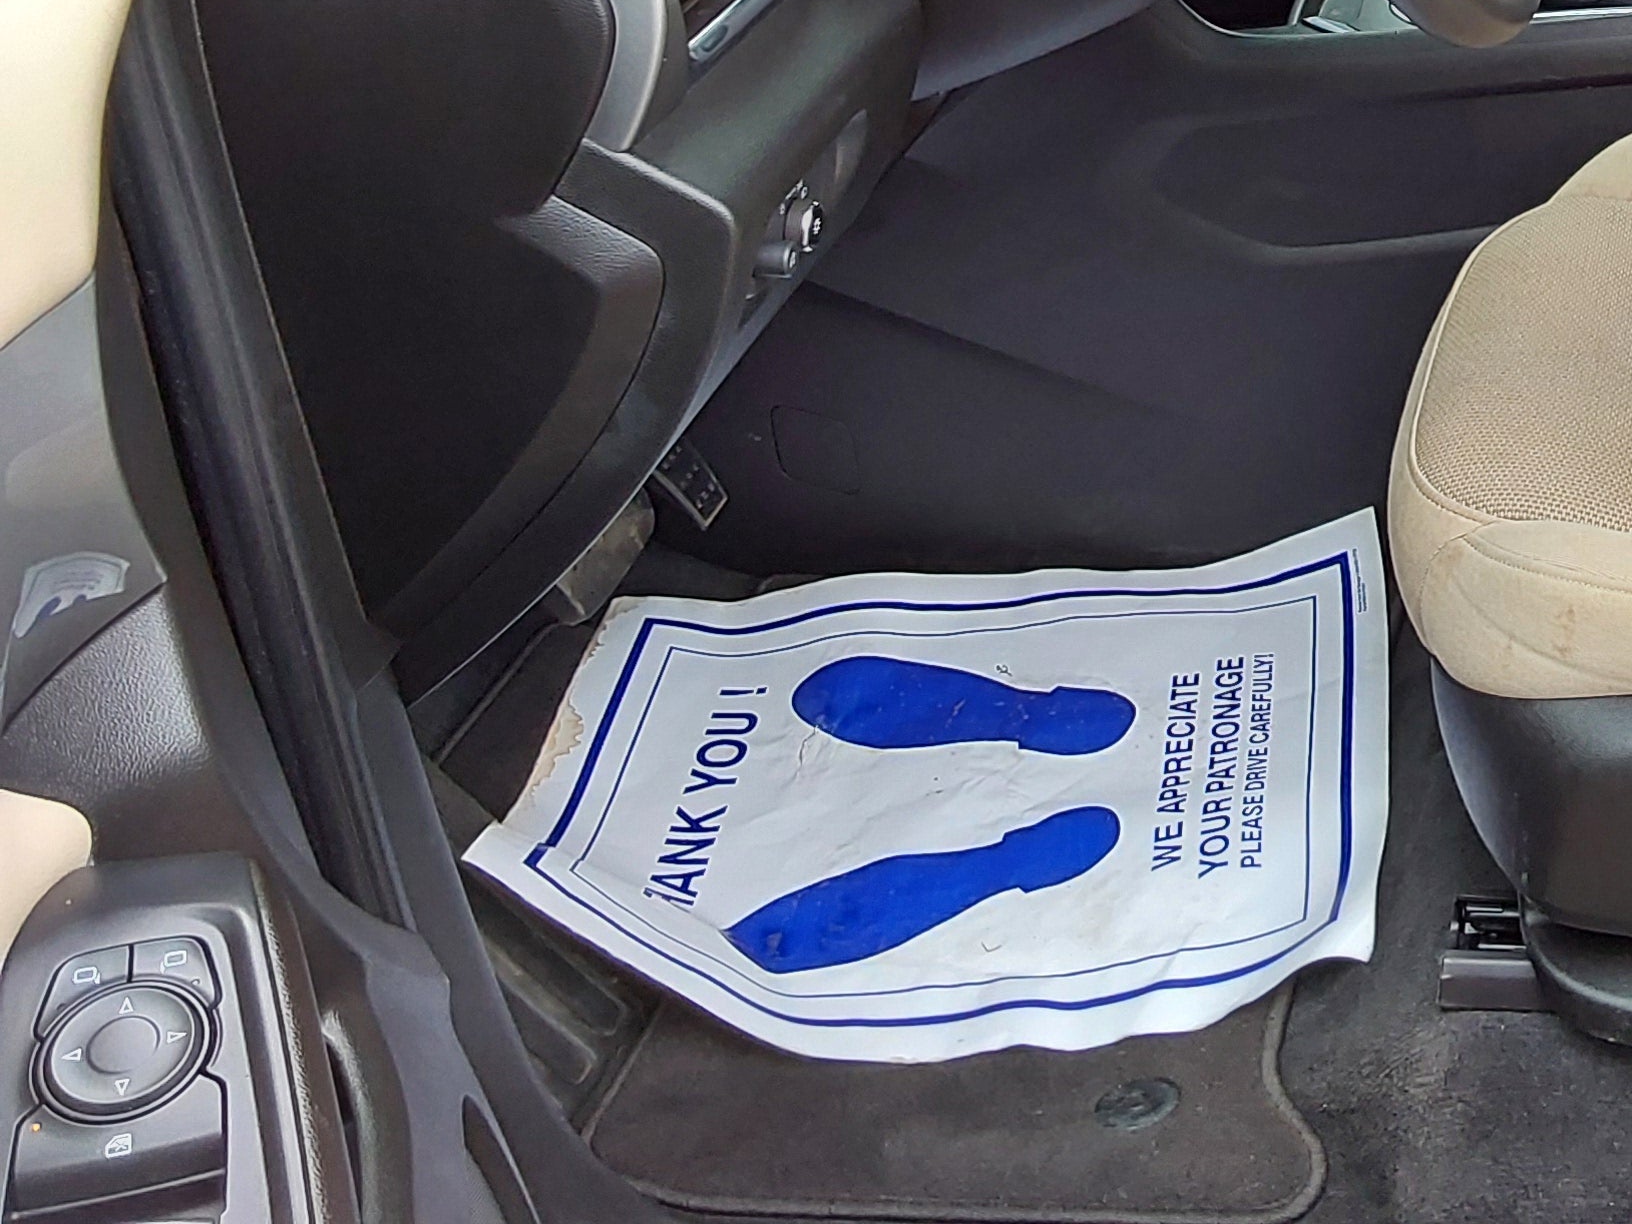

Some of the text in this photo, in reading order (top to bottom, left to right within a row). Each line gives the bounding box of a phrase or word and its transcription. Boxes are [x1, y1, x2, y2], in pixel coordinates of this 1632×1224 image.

[682, 712, 760, 795] YOU
[1151, 672, 1200, 872] WE APPRECIATE
[1198, 656, 1244, 879] YOUR PATRONAGE
[1240, 653, 1275, 868] PLEASE DRIVE CAREFULLY!
